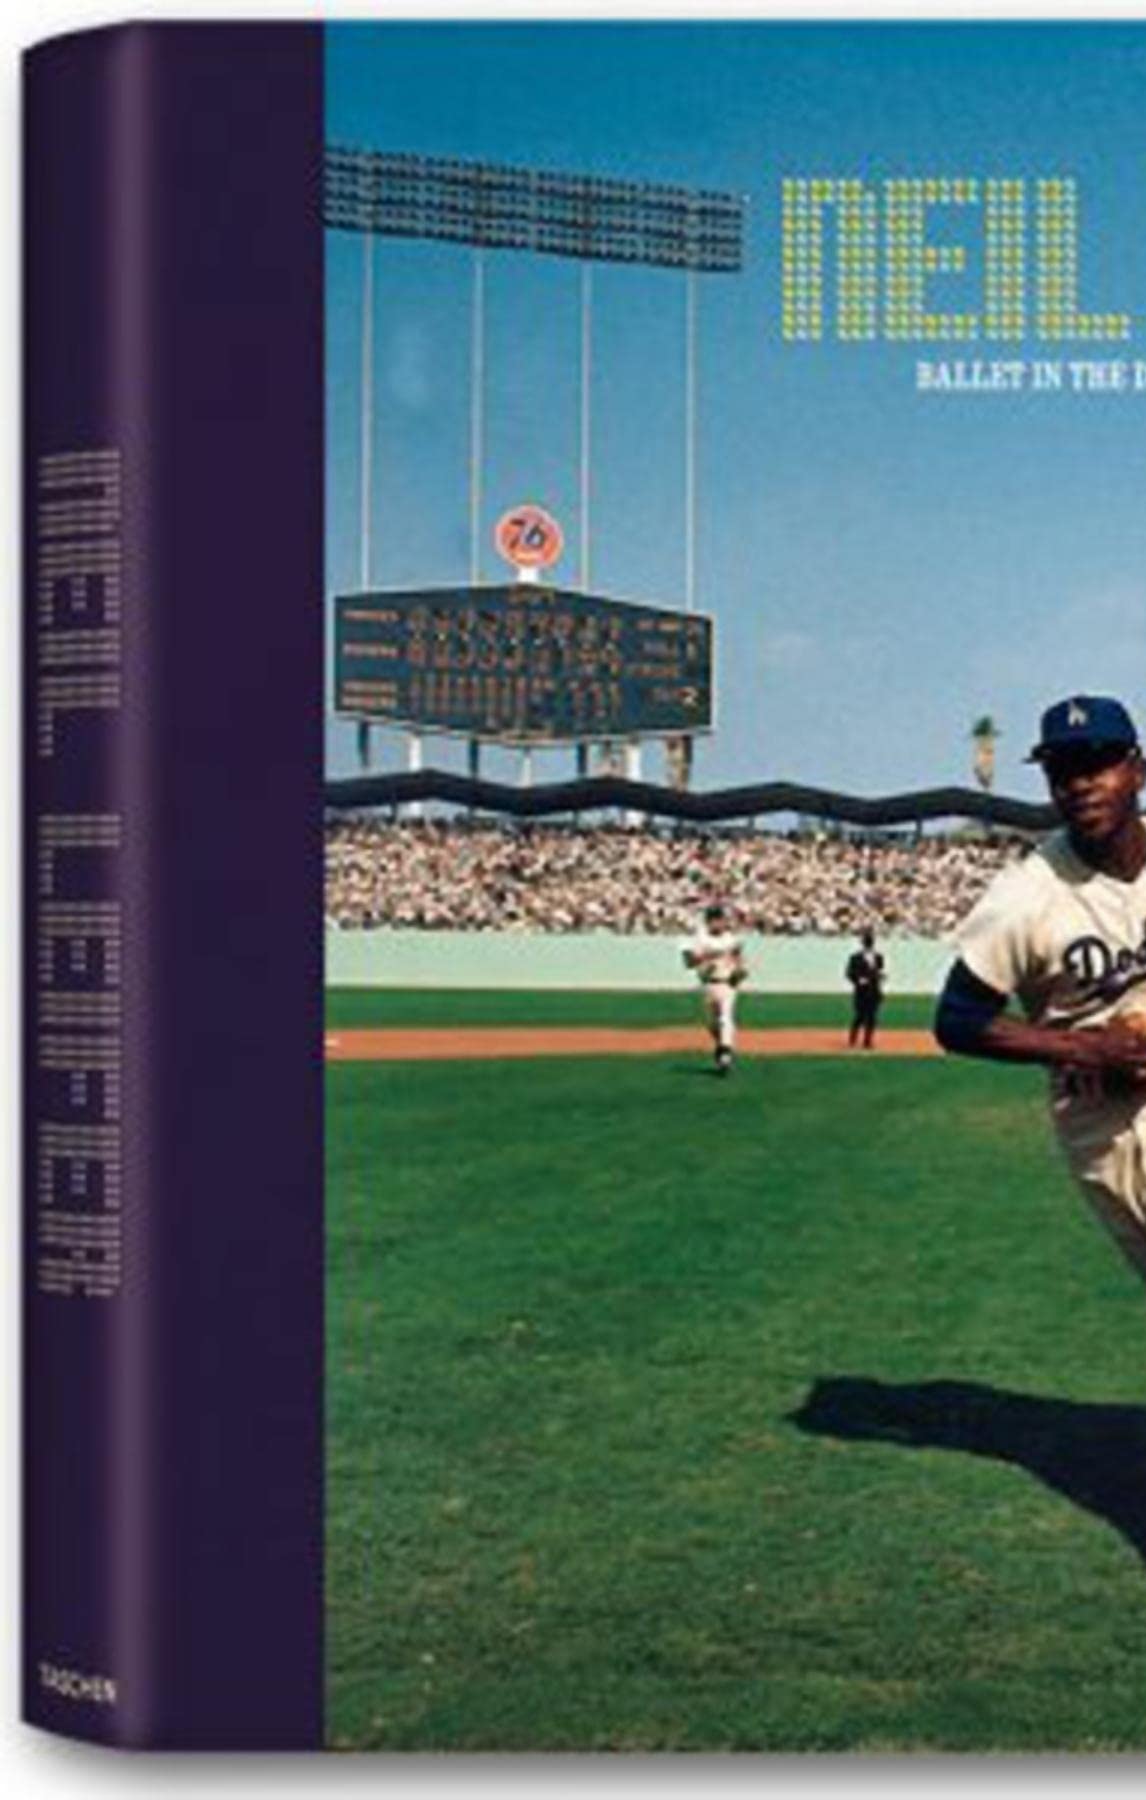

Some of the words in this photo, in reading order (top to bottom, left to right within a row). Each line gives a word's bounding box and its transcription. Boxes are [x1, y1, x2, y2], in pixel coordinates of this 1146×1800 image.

[781, 178, 1131, 341] NEIL
[916, 360, 1025, 389] BALLET
[1032, 360, 1062, 389] IN
[1070, 360, 1126, 389] THE
[509, 518, 546, 550] 76
